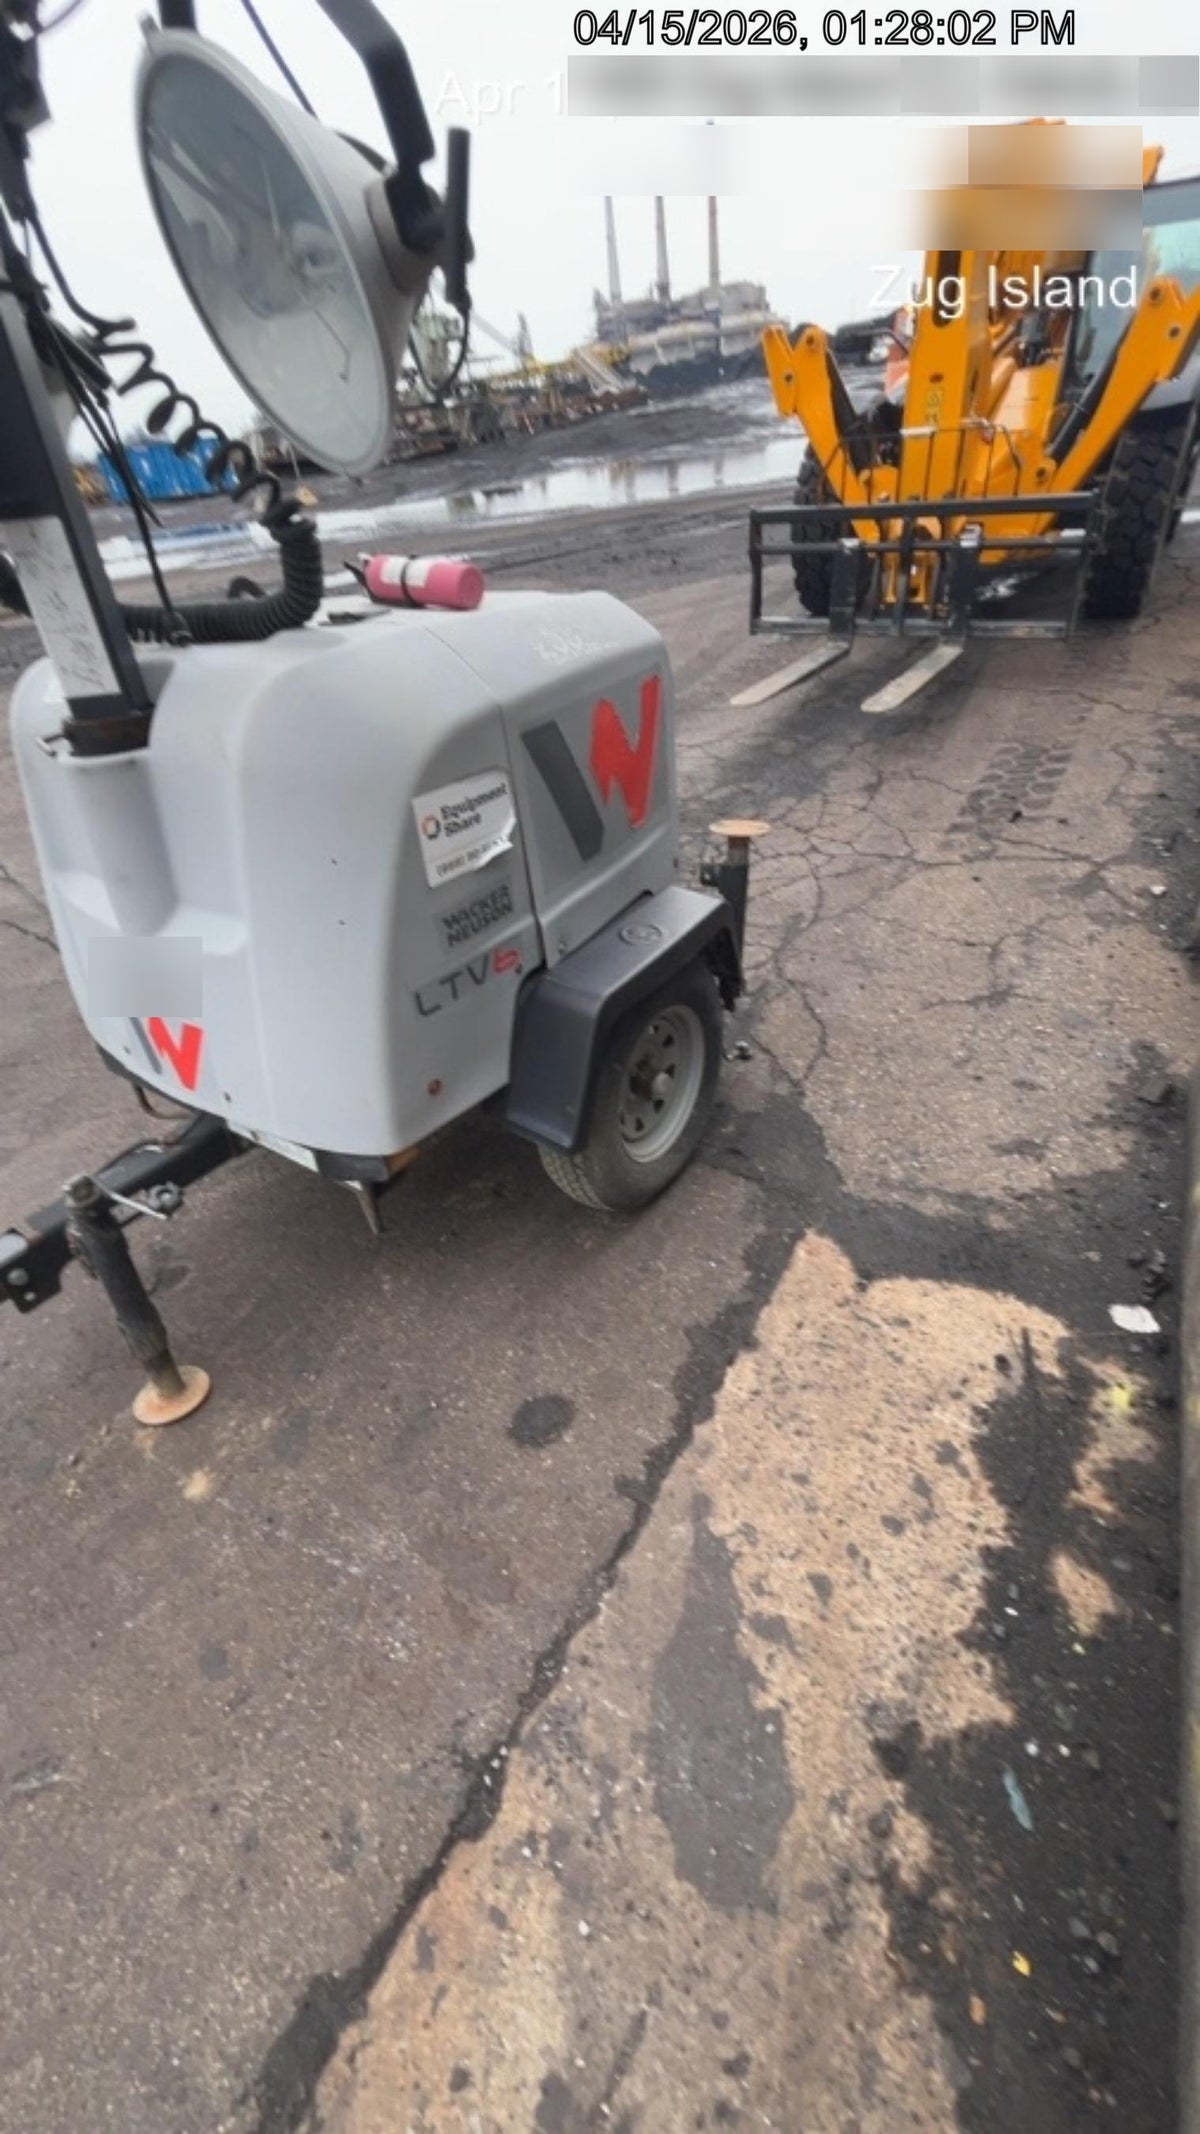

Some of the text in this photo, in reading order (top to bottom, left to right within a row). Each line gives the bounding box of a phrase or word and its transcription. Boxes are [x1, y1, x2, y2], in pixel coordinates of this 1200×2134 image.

[439, 782, 508, 822] Equipment
[442, 812, 482, 838] Share
[441, 884, 510, 930] WACKER
[447, 901, 514, 947] NEUSON
